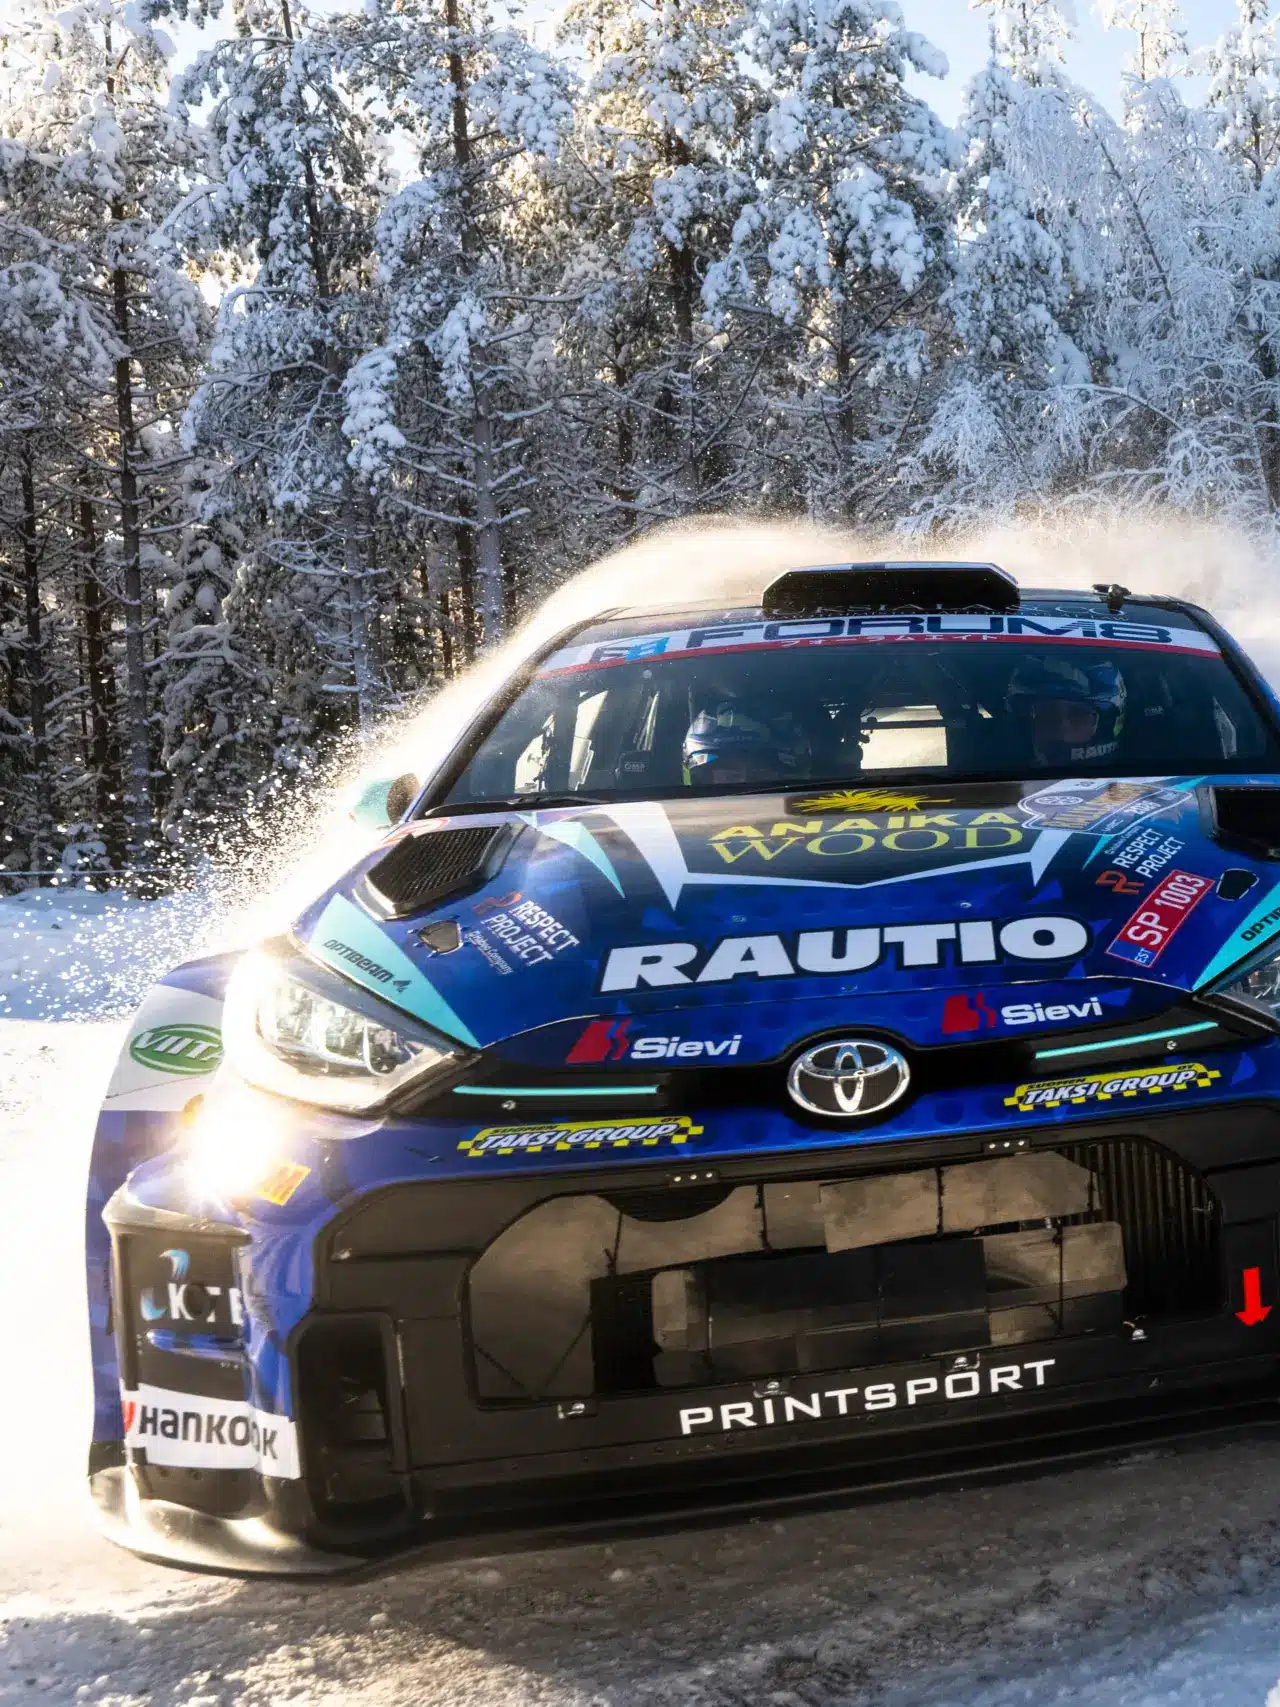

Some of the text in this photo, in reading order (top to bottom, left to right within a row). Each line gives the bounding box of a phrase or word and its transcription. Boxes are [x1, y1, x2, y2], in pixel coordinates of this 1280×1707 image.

[686, 616, 1172, 648] FORUM8
[708, 812, 1019, 840] ANAIKA
[707, 827, 1022, 864] WOOD
[1112, 828, 1164, 868] RESPECT
[1135, 836, 1186, 878] PROJECT
[511, 900, 580, 953] RESPECT
[1127, 875, 1205, 945] SP 1003
[483, 914, 554, 966] PROJECT
[600, 916, 1088, 992] RAUTIO
[1135, 949, 1151, 965] EST
[1000, 997, 1103, 1025] Sievi
[630, 1035, 742, 1060] Sievi
[1024, 1070, 1197, 1105] TAKSI GROUP
[1027, 1078, 1086, 1089] SUOMEN
[477, 1123, 680, 1150] TAKSI GROUP
[679, 1359, 1055, 1435] PRINTSPORT
